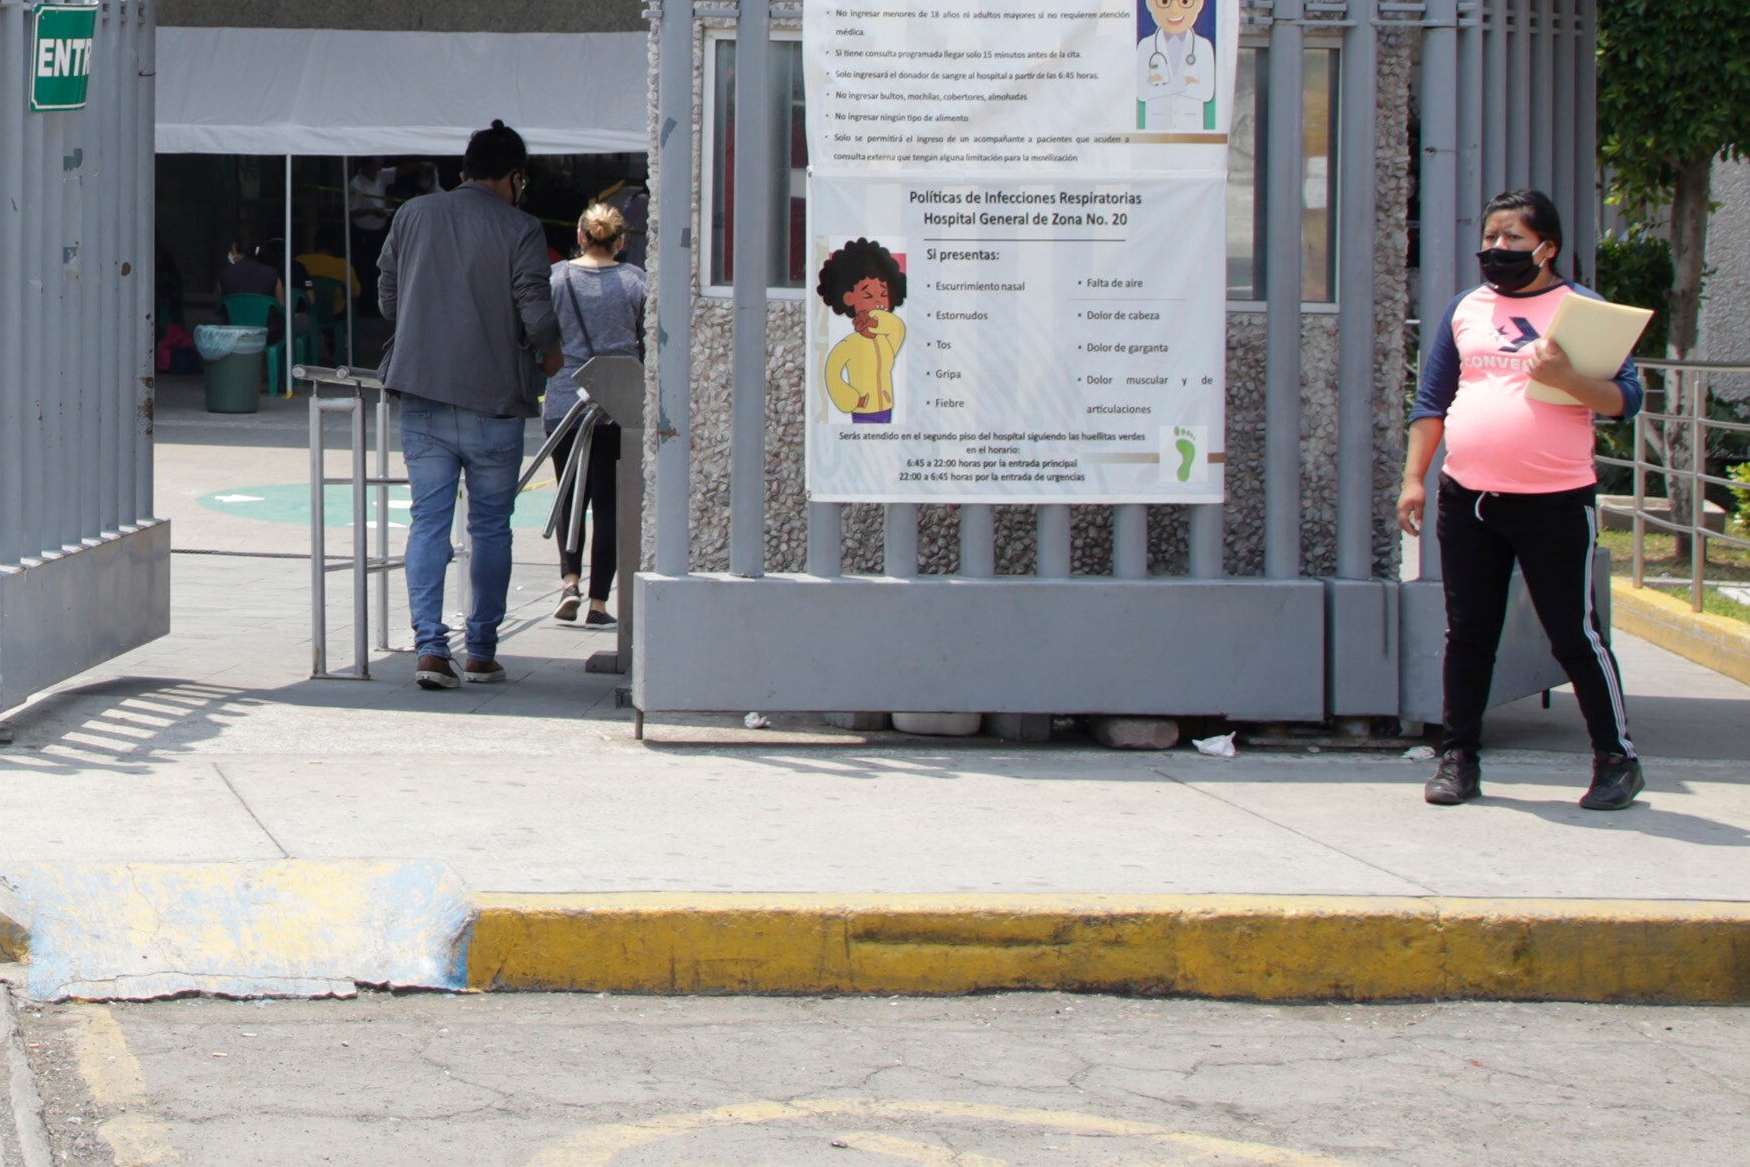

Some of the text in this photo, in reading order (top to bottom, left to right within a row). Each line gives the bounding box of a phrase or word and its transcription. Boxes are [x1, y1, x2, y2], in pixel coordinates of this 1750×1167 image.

[37, 38, 93, 77] ENTR
[909, 190, 1142, 206] Políticas de Infecciones Respiratorias
[923, 212, 1127, 227] Hospital General de Zona No. 20
[926, 248, 999, 262] Si presentas:
[935, 281, 1025, 291] Escurrimiento nasal
[1086, 277, 1143, 288] Falta de aire
[936, 310, 988, 320] Estornudos
[1086, 310, 1160, 320] Dolor de cabeza
[936, 339, 951, 349] Tos
[1086, 342, 1168, 354] Dolor de garganta
[935, 368, 961, 380] Gripa
[1086, 374, 1213, 386] Dolor muscular y de
[935, 398, 965, 407] Fiebre
[1086, 404, 1152, 414] articulaciones
